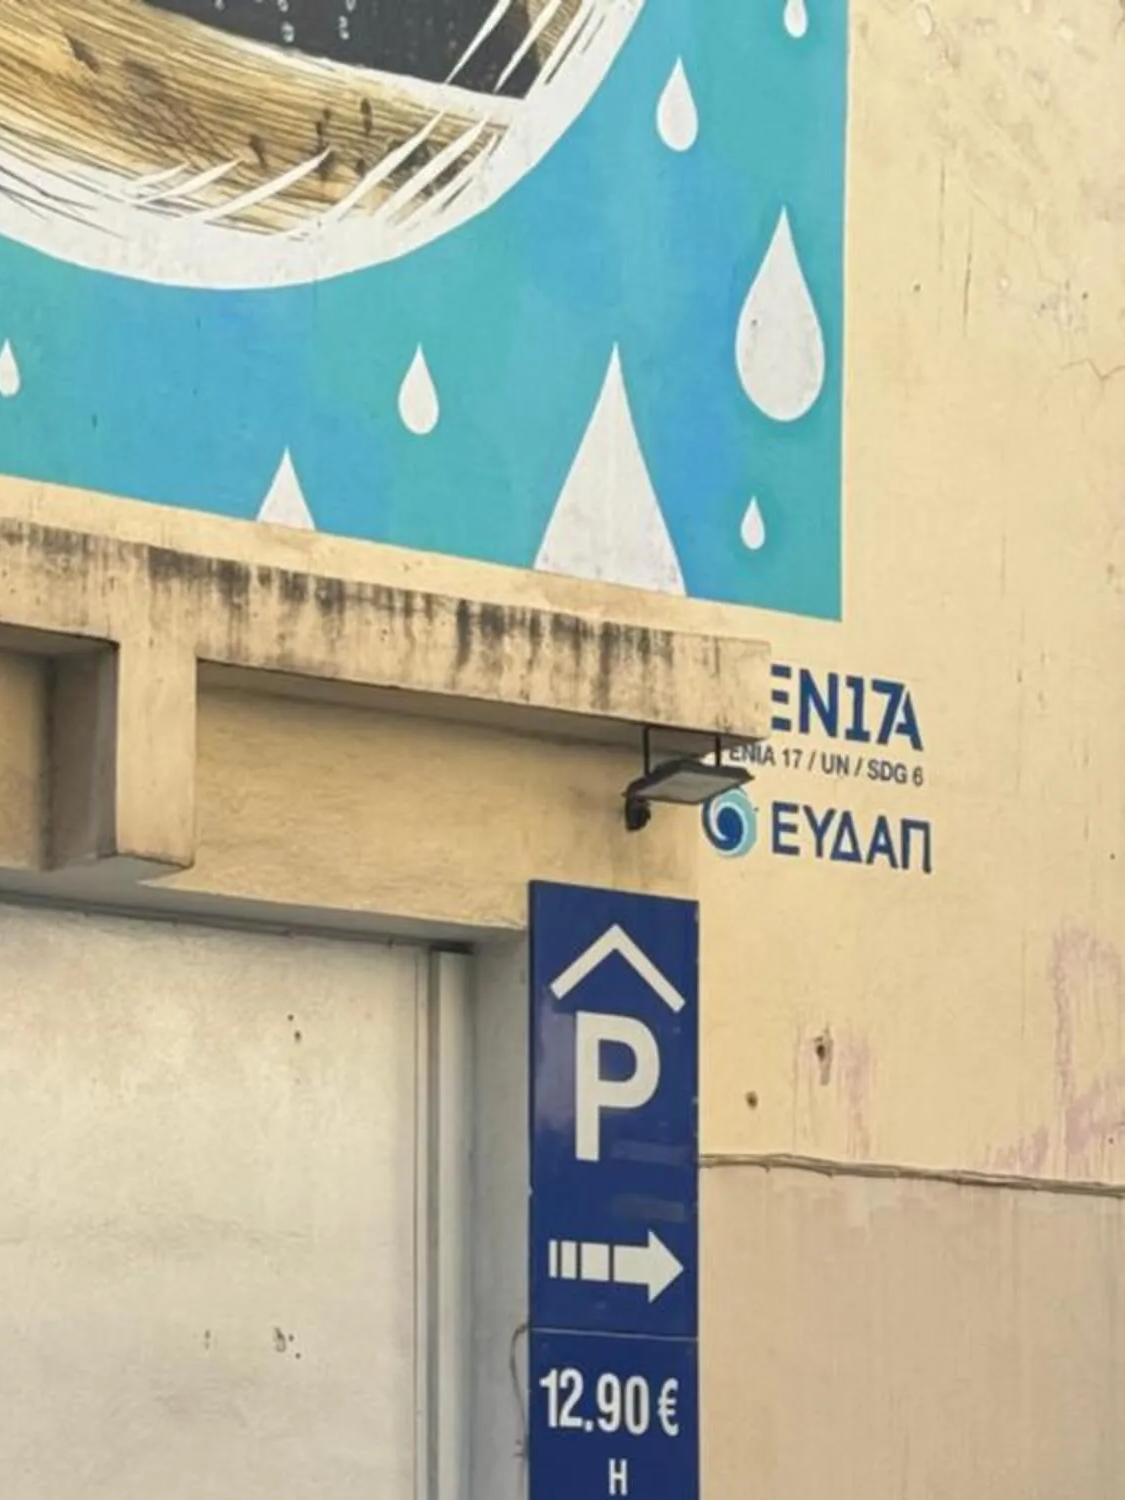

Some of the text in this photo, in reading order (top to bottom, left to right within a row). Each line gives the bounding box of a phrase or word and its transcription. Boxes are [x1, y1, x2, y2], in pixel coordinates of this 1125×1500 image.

[770, 663, 923, 751] EN17A
[782, 748, 803, 769] 17
[821, 752, 850, 776] UN
[867, 759, 908, 785] SDG
[912, 766, 924, 787] 6
[771, 800, 932, 874] ΕΥΔΑΠ
[576, 1010, 660, 1162] P
[608, 1458, 627, 1496] Η
